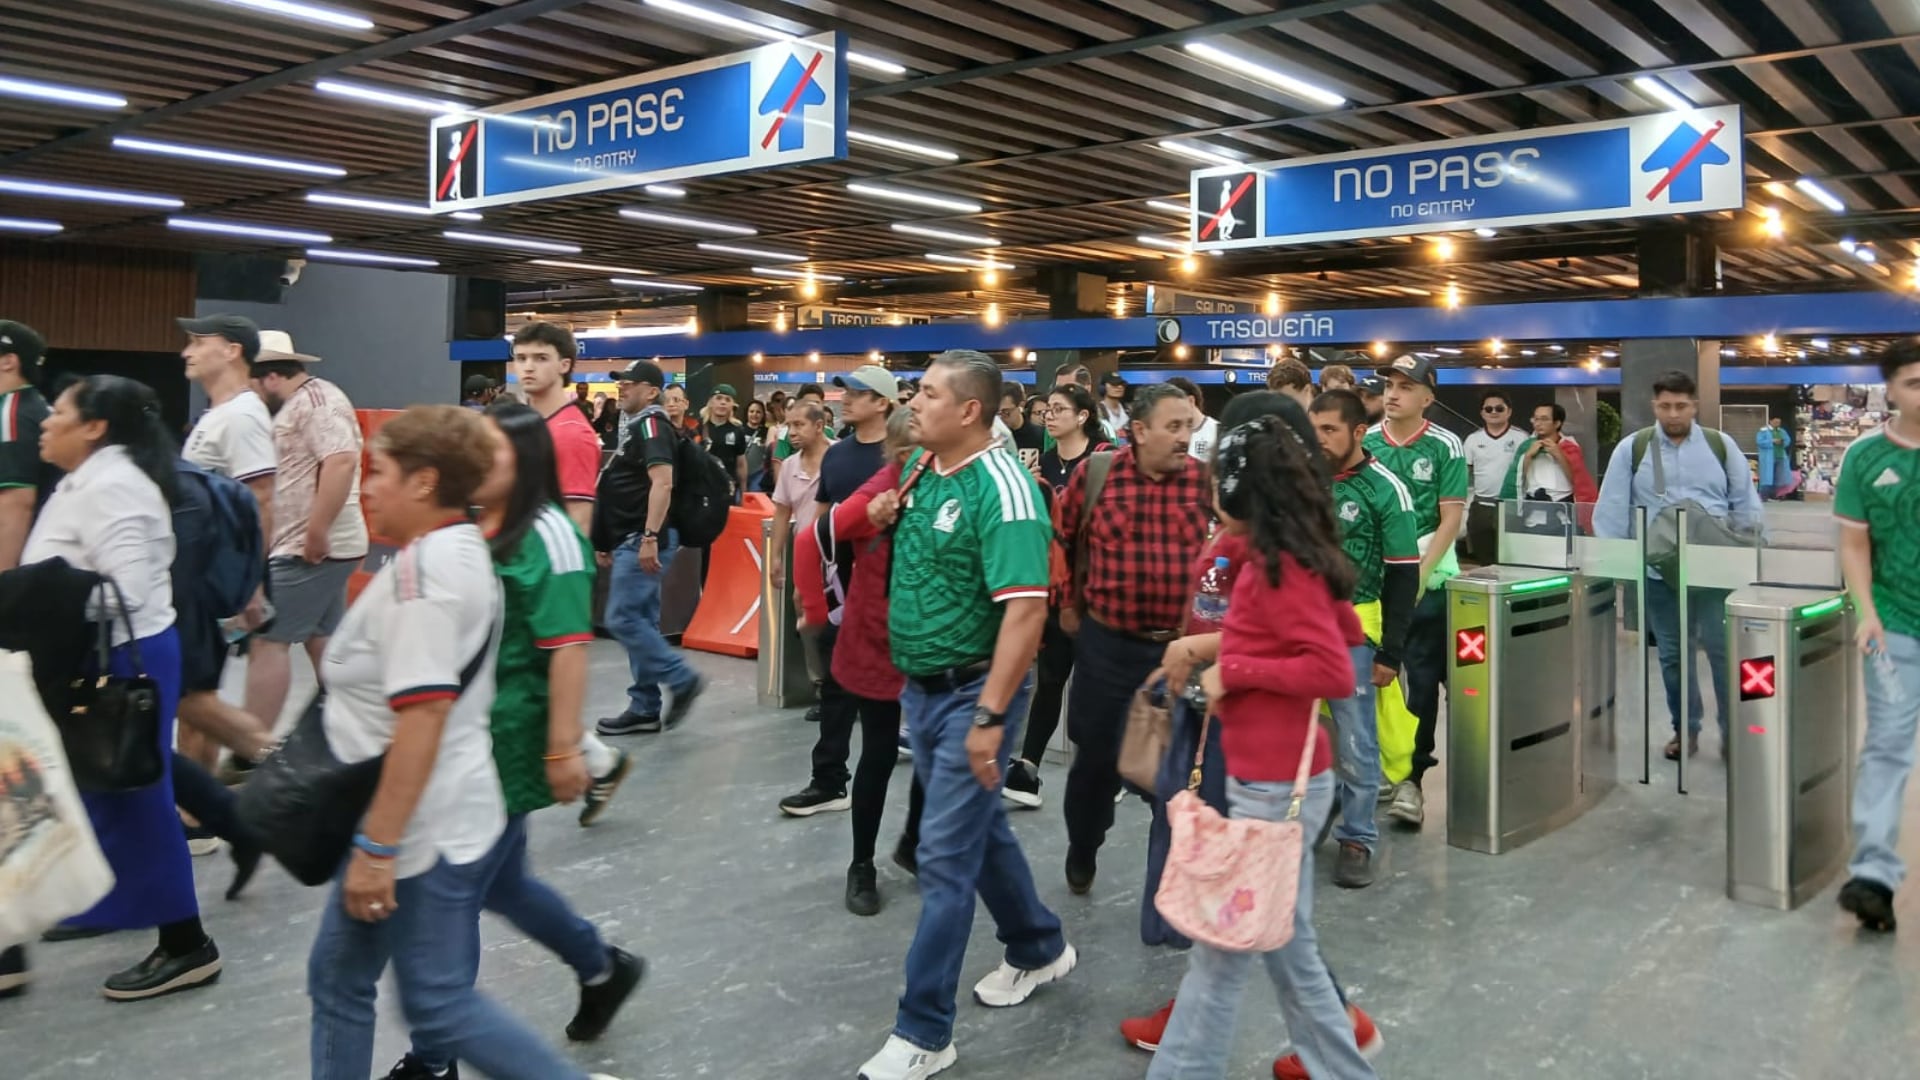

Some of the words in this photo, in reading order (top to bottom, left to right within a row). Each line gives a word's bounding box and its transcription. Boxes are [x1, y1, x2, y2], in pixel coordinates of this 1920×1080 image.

[533, 110, 577, 155] NO
[588, 88, 685, 146] PASE
[574, 158, 593, 173] NO
[594, 149, 637, 171] ENTRY
[1333, 166, 1393, 202] NO
[1408, 148, 1541, 194] PASE
[1391, 205, 1414, 217] NO
[1418, 198, 1475, 215] ENTRY
[1207, 314, 1333, 339] TASQUEÑA
